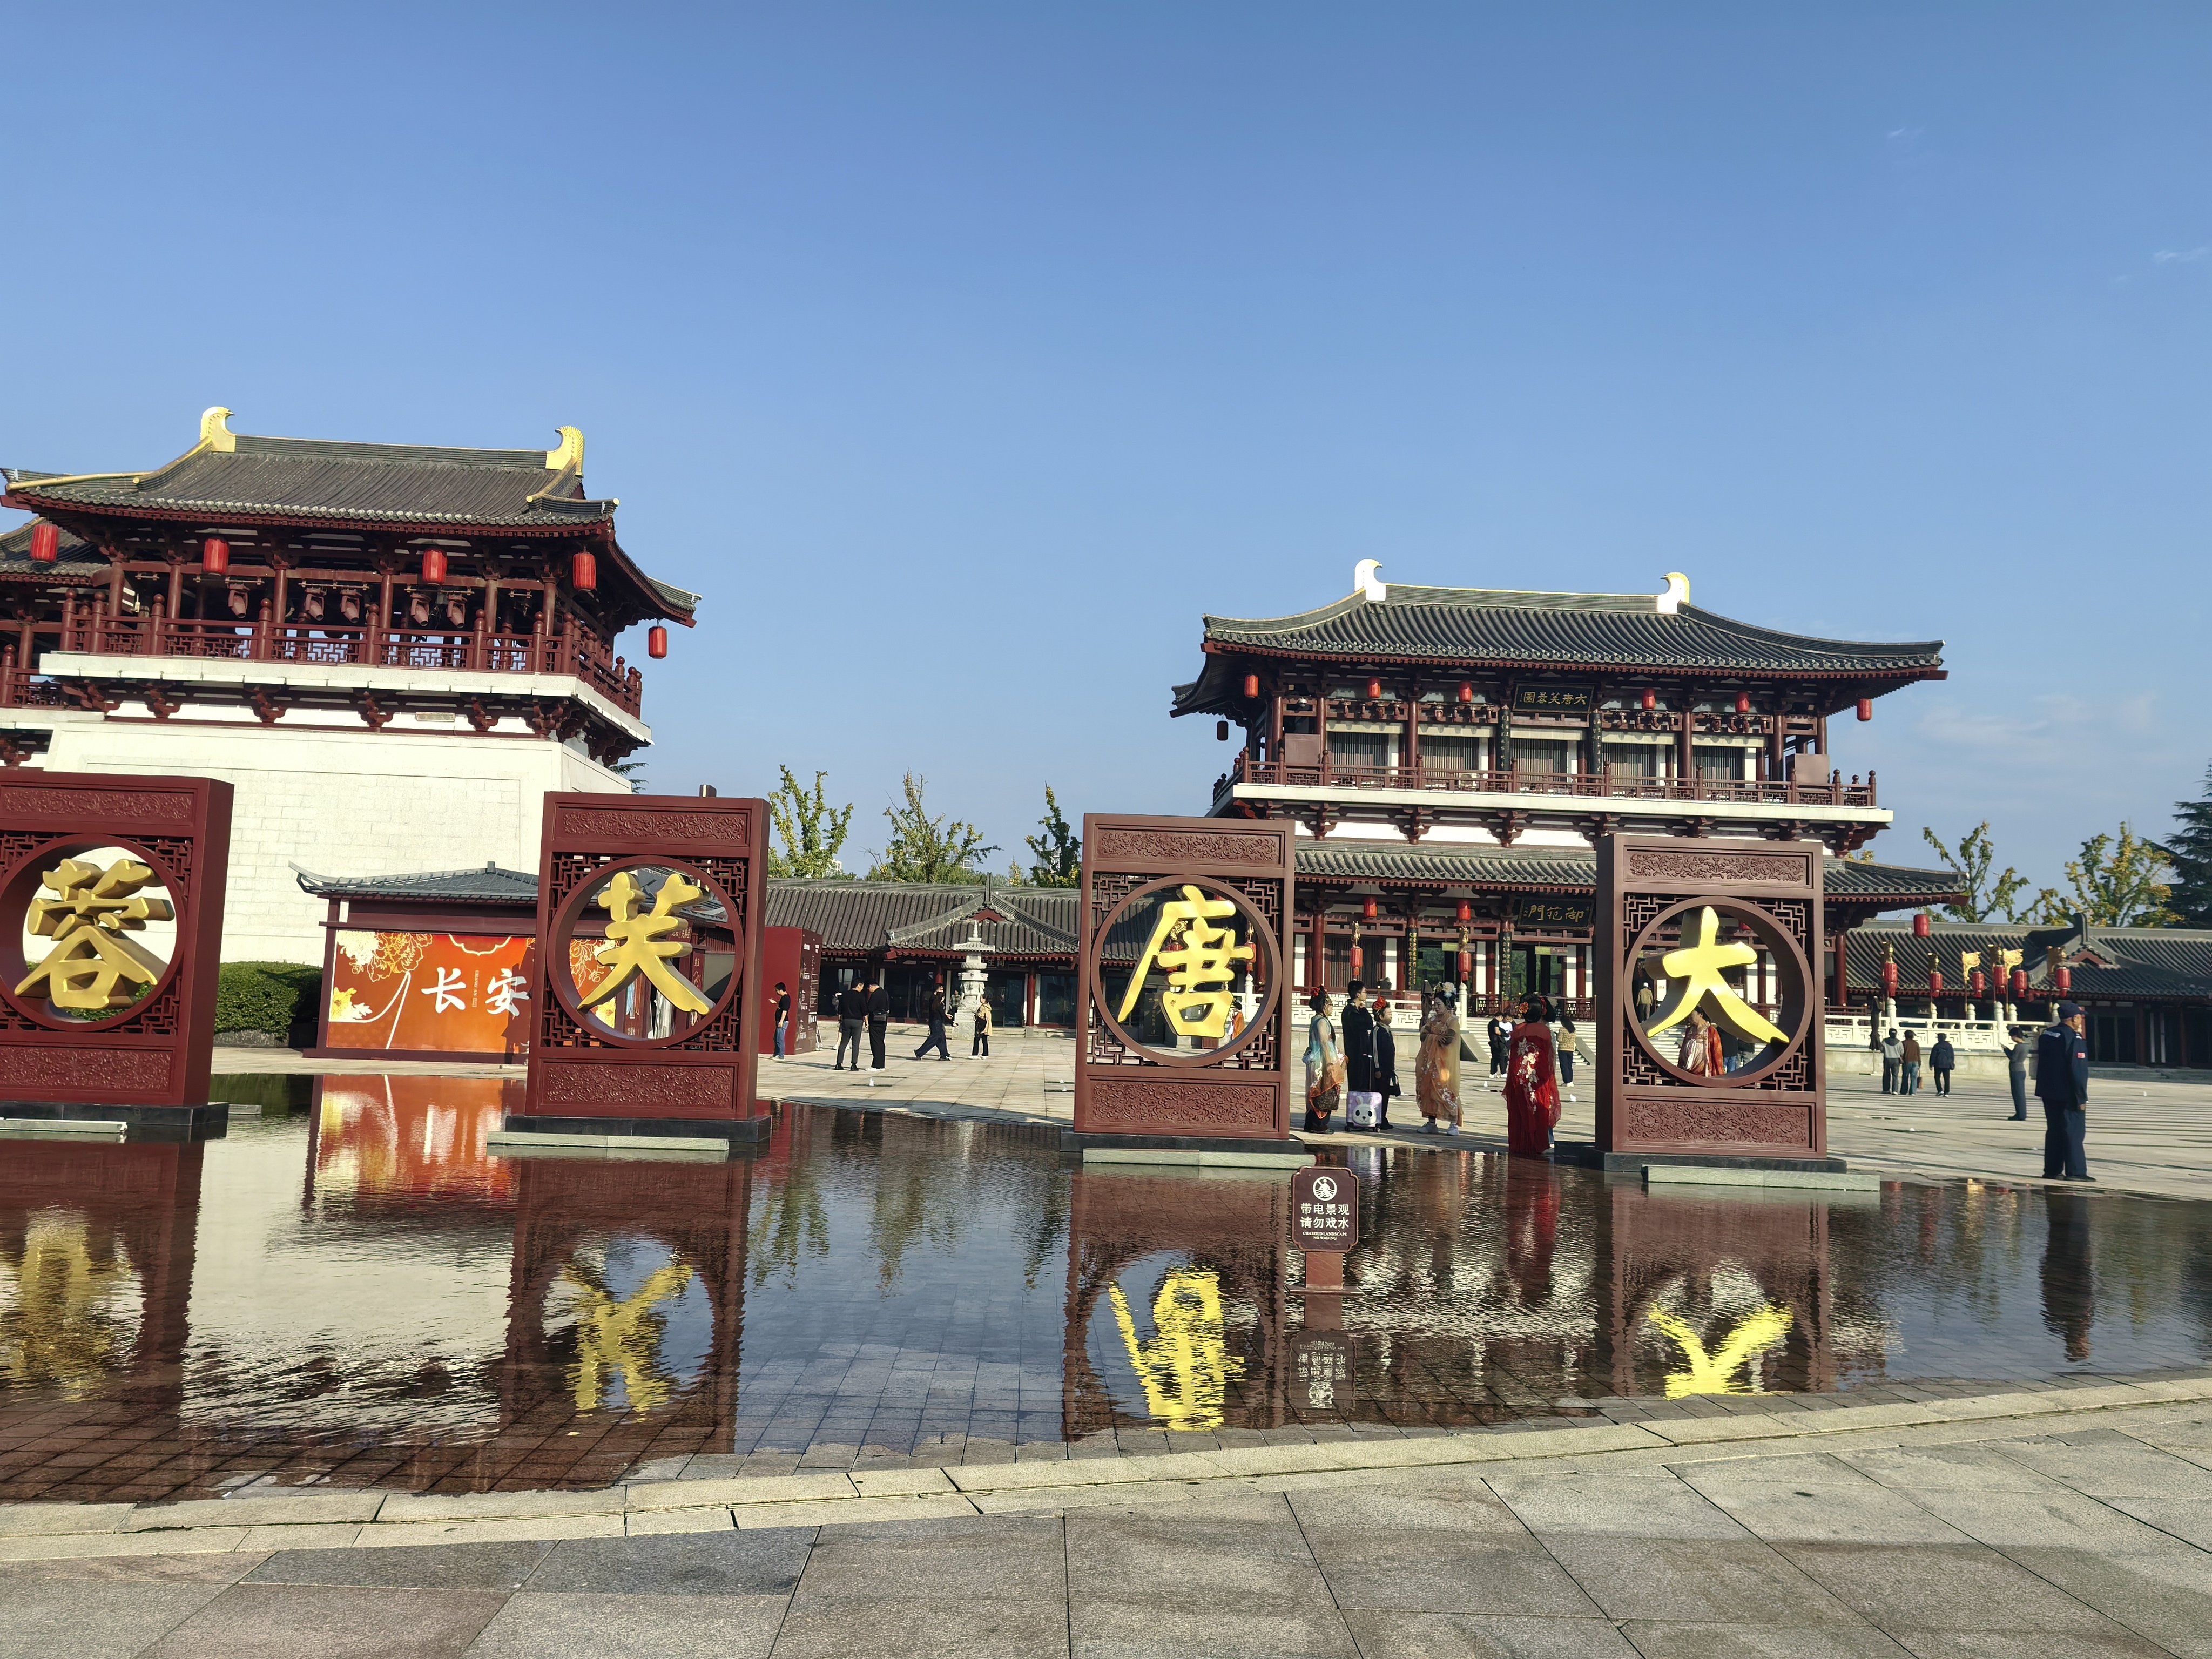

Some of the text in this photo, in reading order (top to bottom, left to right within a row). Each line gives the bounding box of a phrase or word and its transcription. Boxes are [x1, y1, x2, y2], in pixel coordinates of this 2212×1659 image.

[14, 858, 170, 1009] 蓉
[421, 967, 530, 1016] 长安
[578, 871, 711, 1015] 芙
[1117, 884, 1255, 1038] 唐
[1645, 905, 1791, 1044] 大
[1300, 1202, 1350, 1215] 带电景观
[1300, 1216, 1350, 1229] 请勿戏水
